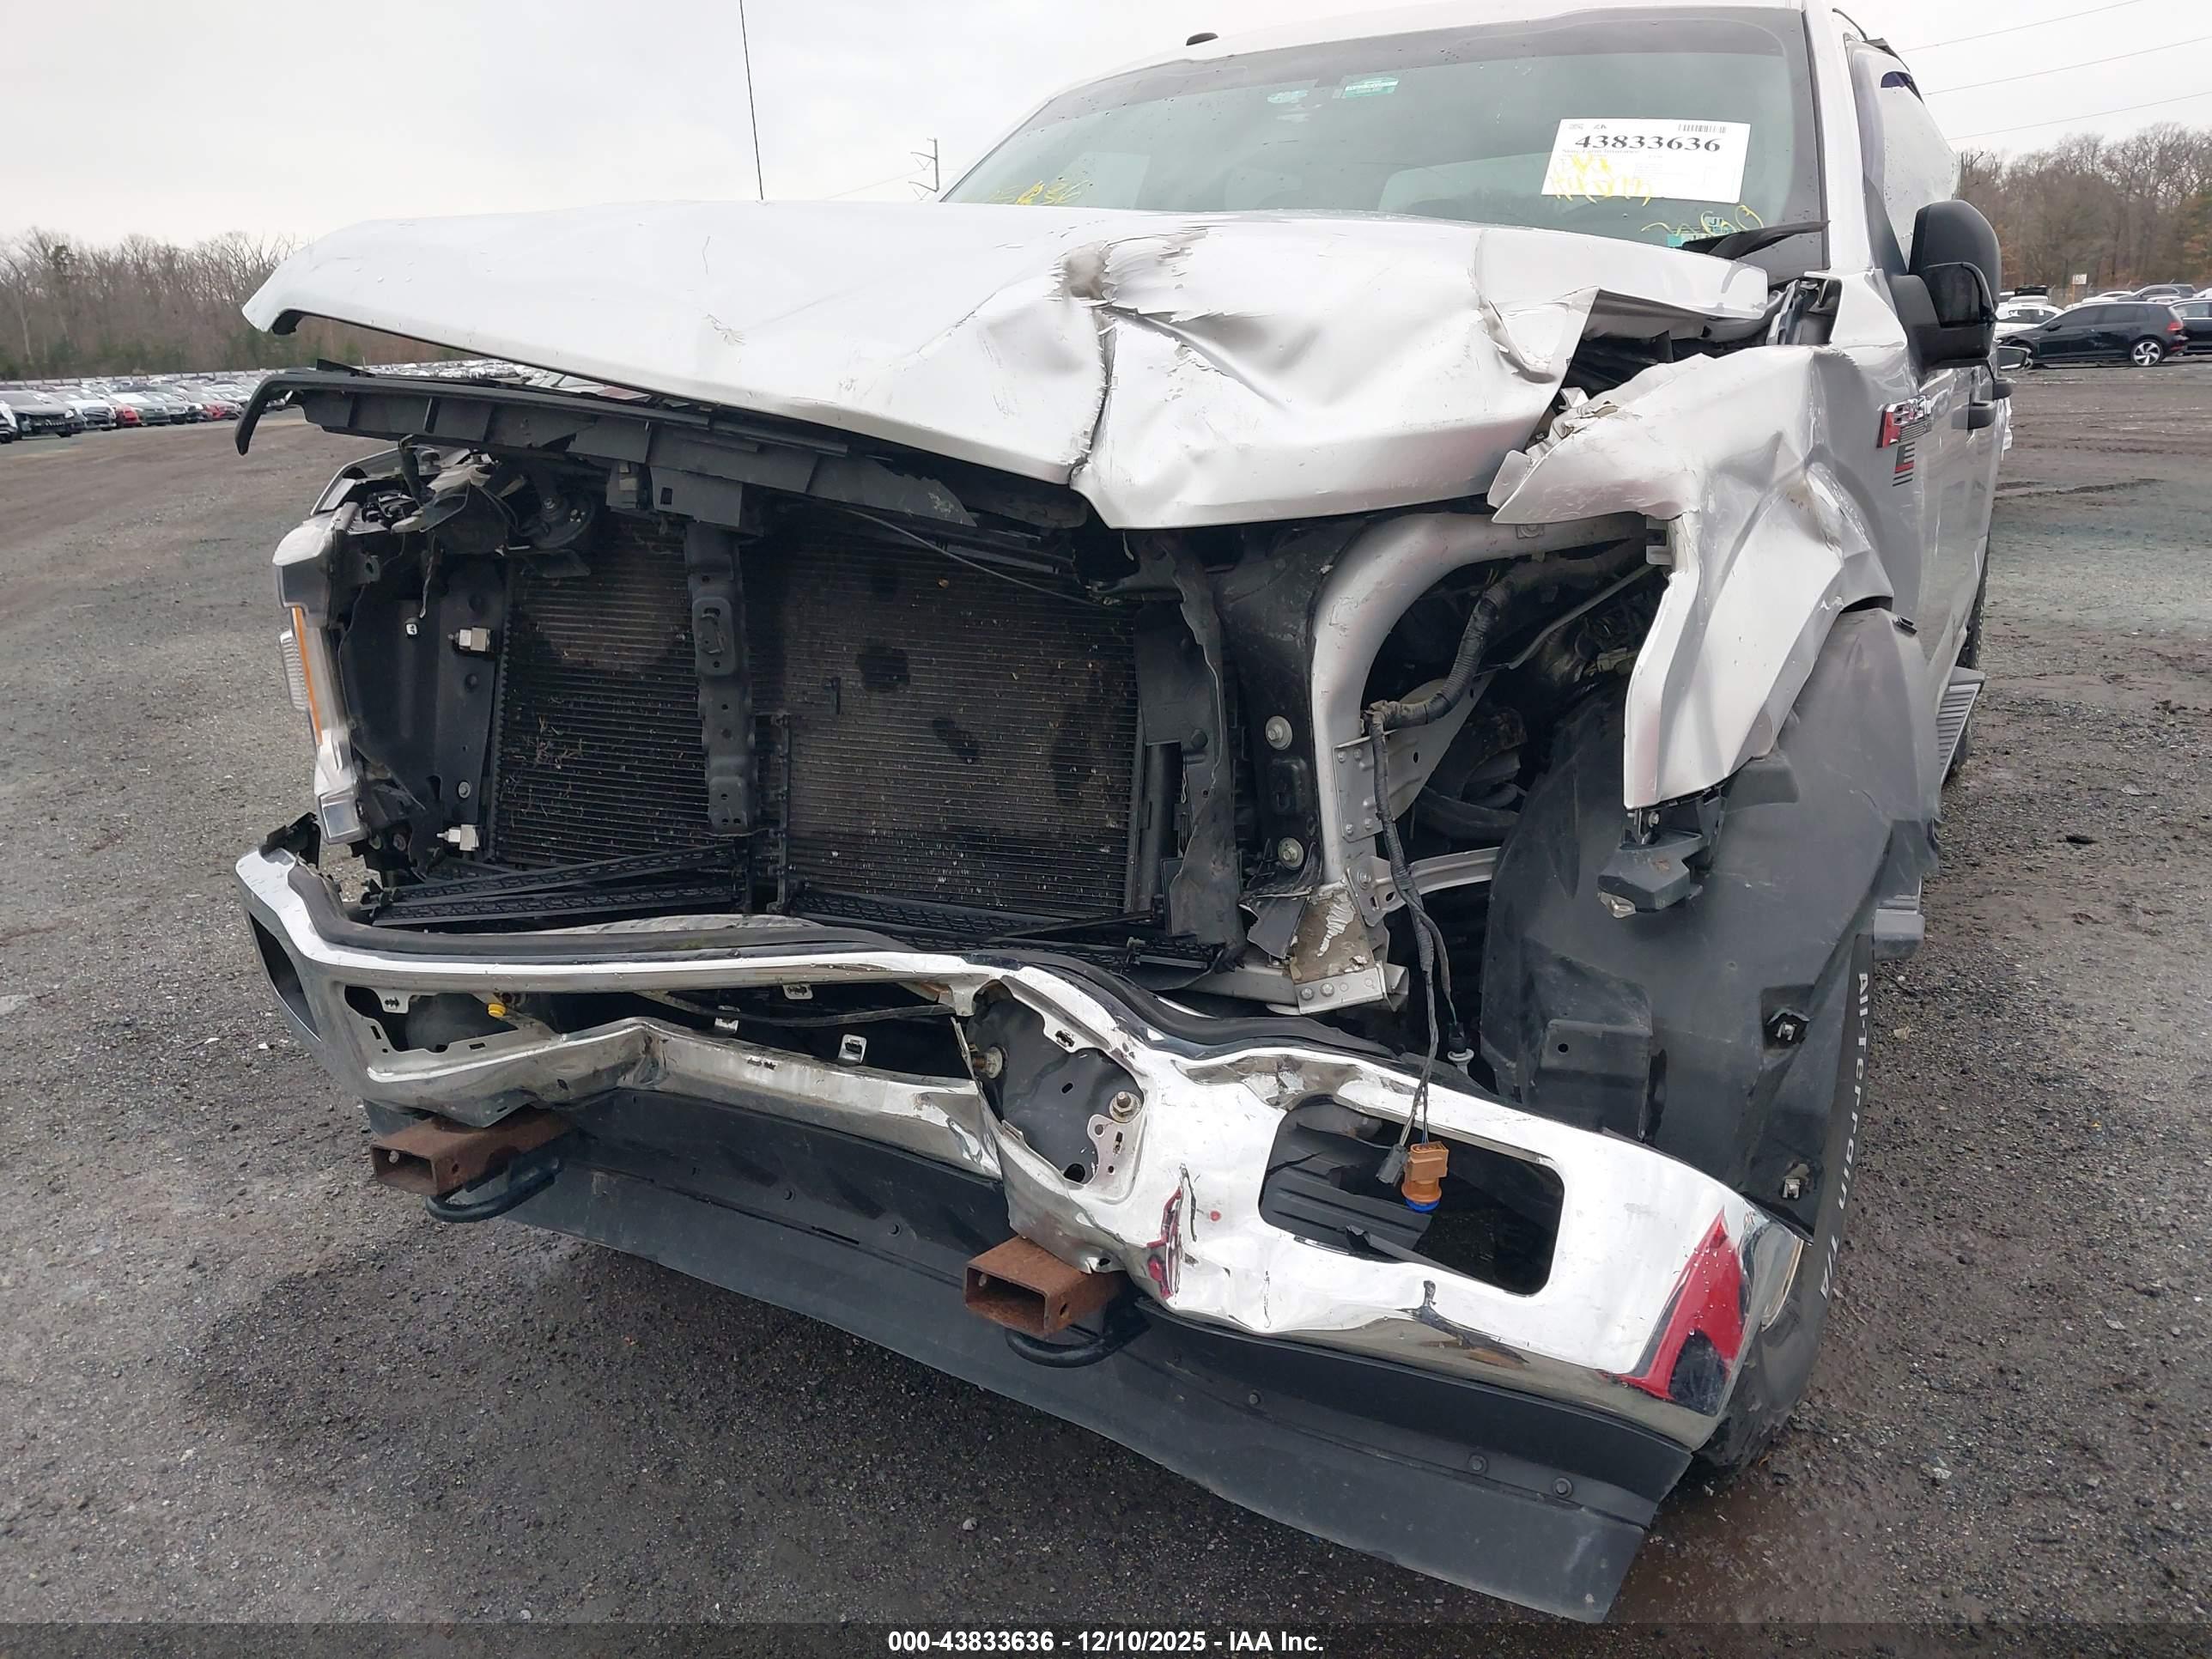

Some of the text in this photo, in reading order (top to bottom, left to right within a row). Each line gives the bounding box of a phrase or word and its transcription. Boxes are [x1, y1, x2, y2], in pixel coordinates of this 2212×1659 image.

[1575, 135, 1723, 152] 43833636
[1820, 973, 1869, 1299] All-Terrain T/A
